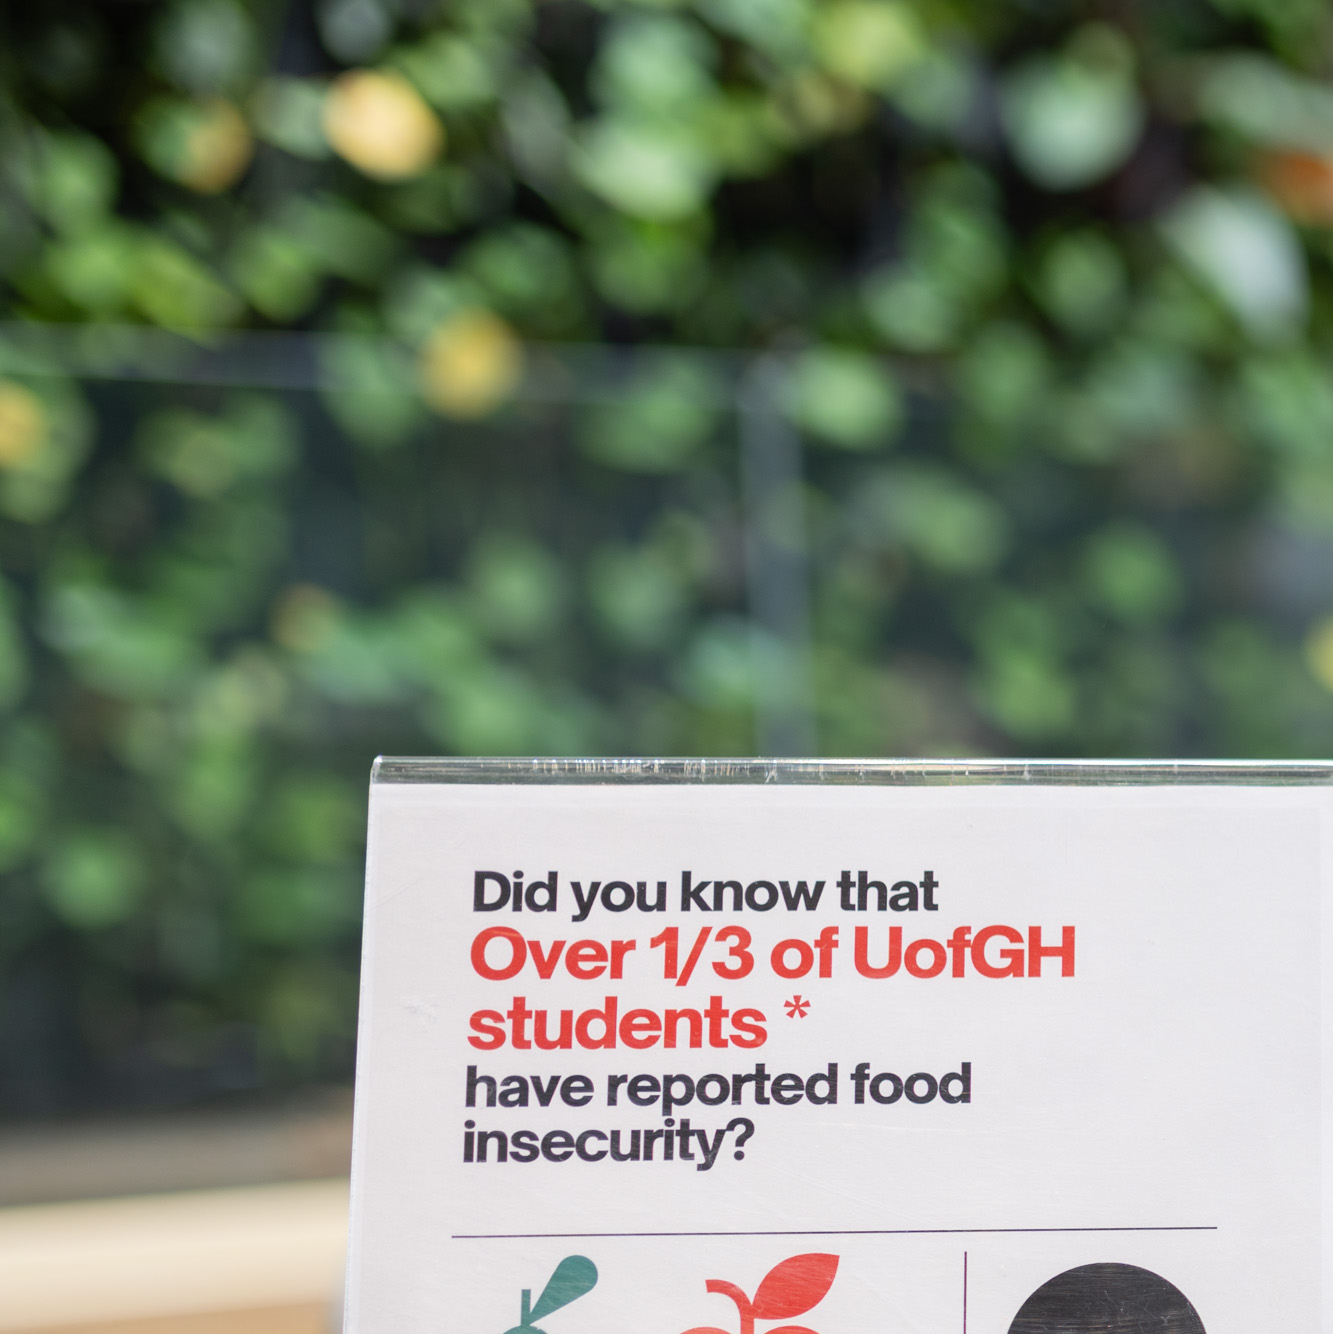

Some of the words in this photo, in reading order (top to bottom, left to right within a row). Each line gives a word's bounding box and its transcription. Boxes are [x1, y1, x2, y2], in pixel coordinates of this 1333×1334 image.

[473, 869, 559, 913] Did
[569, 880, 667, 923] you
[680, 870, 827, 913] know
[835, 870, 940, 913] that
[470, 925, 637, 981] Over
[649, 925, 755, 987] 1/3
[770, 925, 840, 980] of
[853, 924, 1076, 980] UofGH
[467, 995, 768, 1051] students
[465, 1064, 595, 1108] have
[606, 1062, 839, 1117] reported
[849, 1061, 972, 1105] food
[463, 1117, 755, 1172] insecurity?
